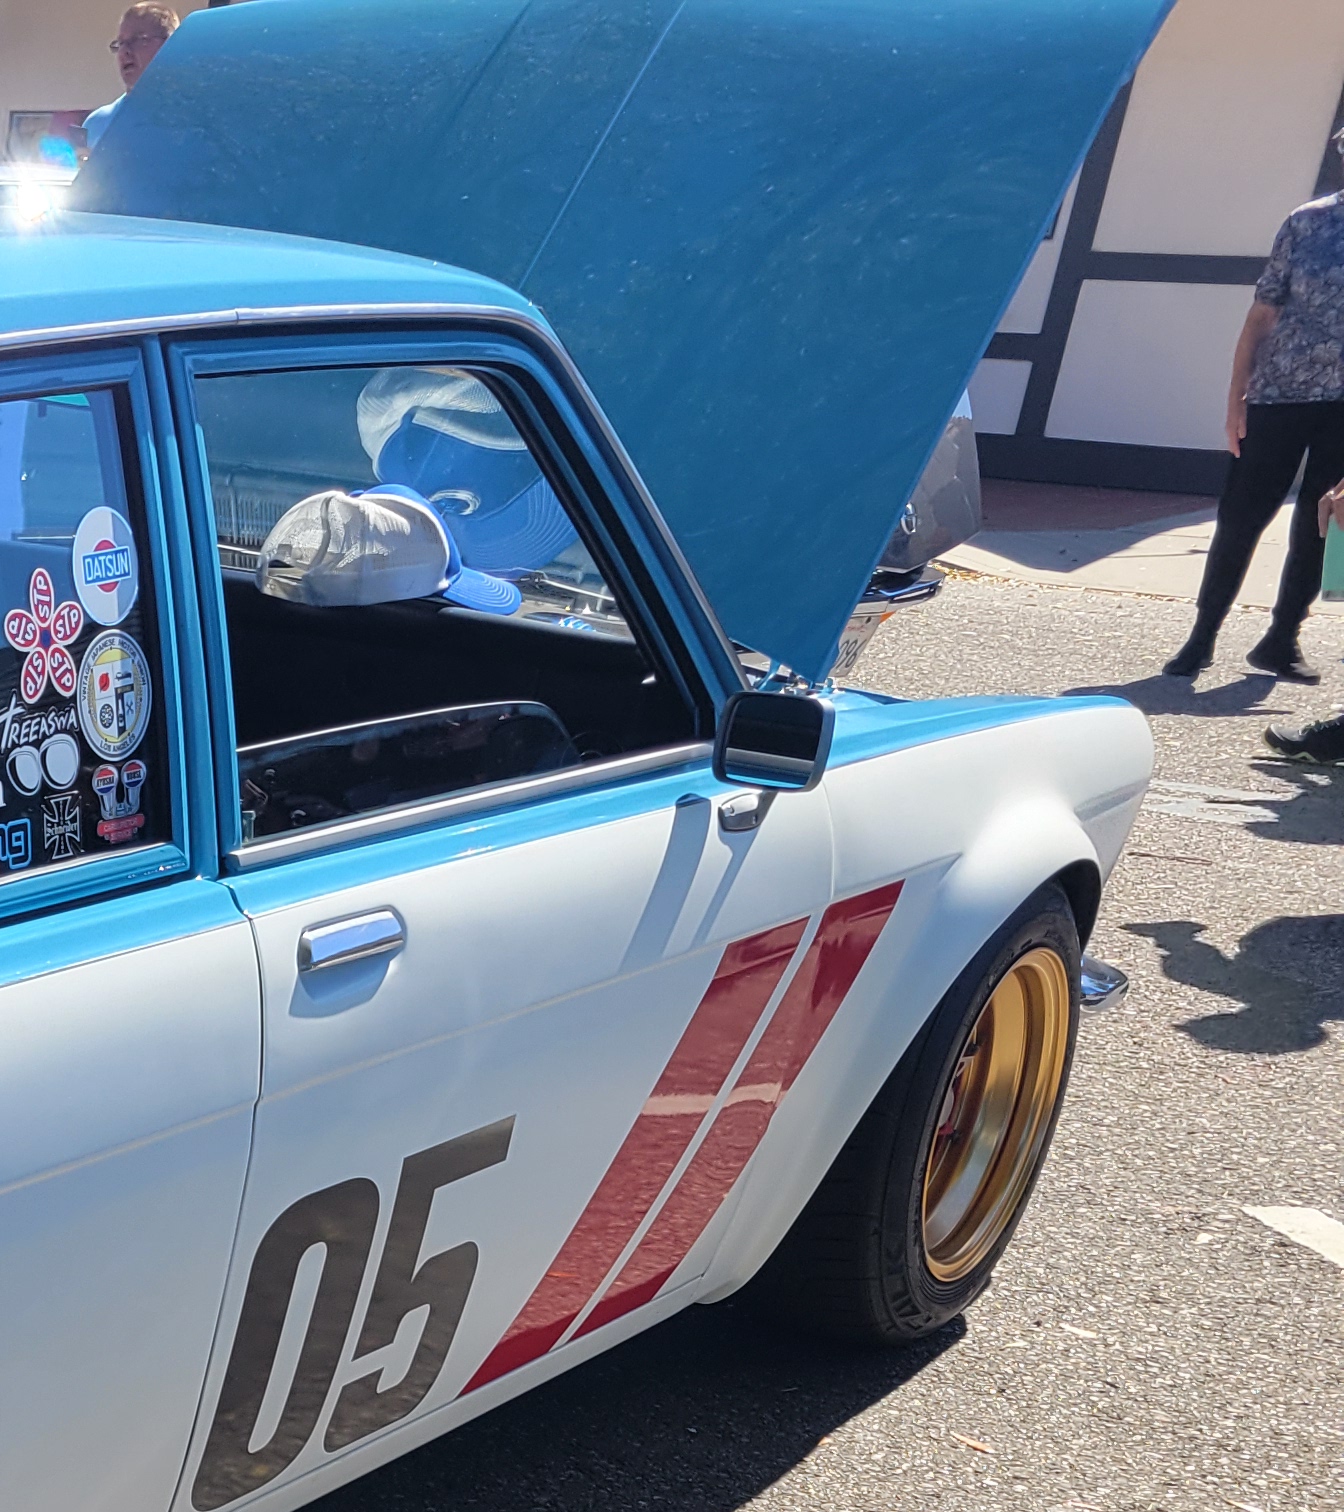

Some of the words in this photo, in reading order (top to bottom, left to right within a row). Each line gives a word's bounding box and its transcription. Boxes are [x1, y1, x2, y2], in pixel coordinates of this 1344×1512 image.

[84, 551, 130, 582] DATSUN
[35, 575, 50, 619] STP
[8, 619, 35, 644] STP
[55, 604, 79, 639] STP
[26, 652, 43, 695] STP
[50, 651, 73, 689] STP
[191, 1113, 517, 1512] 05
